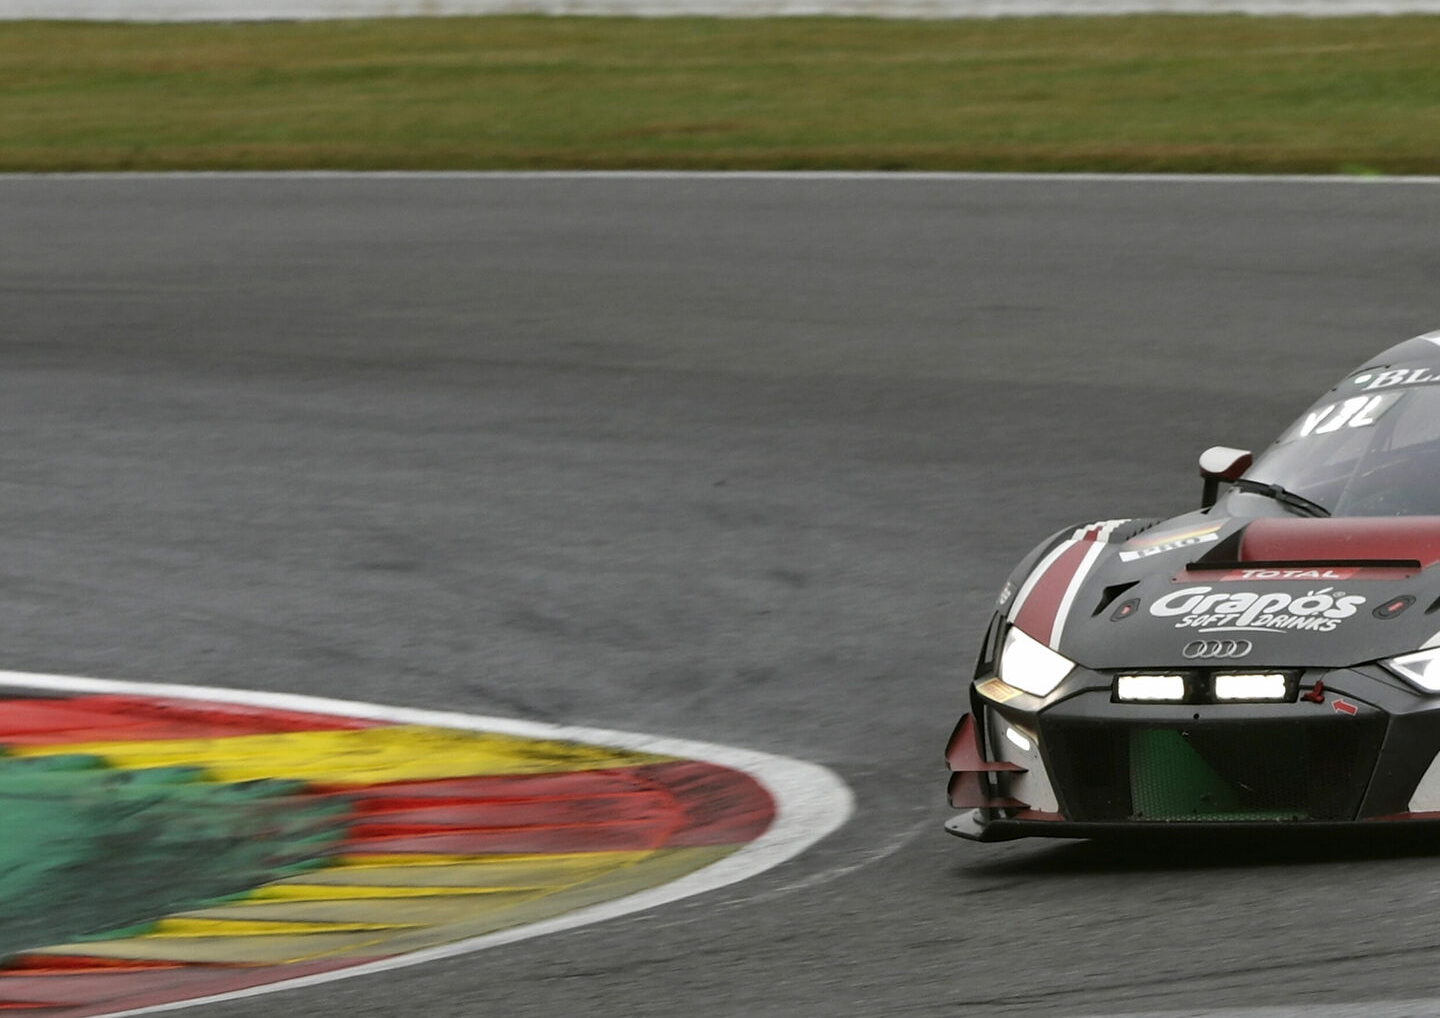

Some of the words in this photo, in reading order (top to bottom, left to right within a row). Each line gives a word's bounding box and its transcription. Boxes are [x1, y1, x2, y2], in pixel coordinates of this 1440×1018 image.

[1241, 568, 1340, 579] TOTAL
[1175, 614, 1238, 628] SOFT
[1250, 613, 1342, 632] DRINKS
